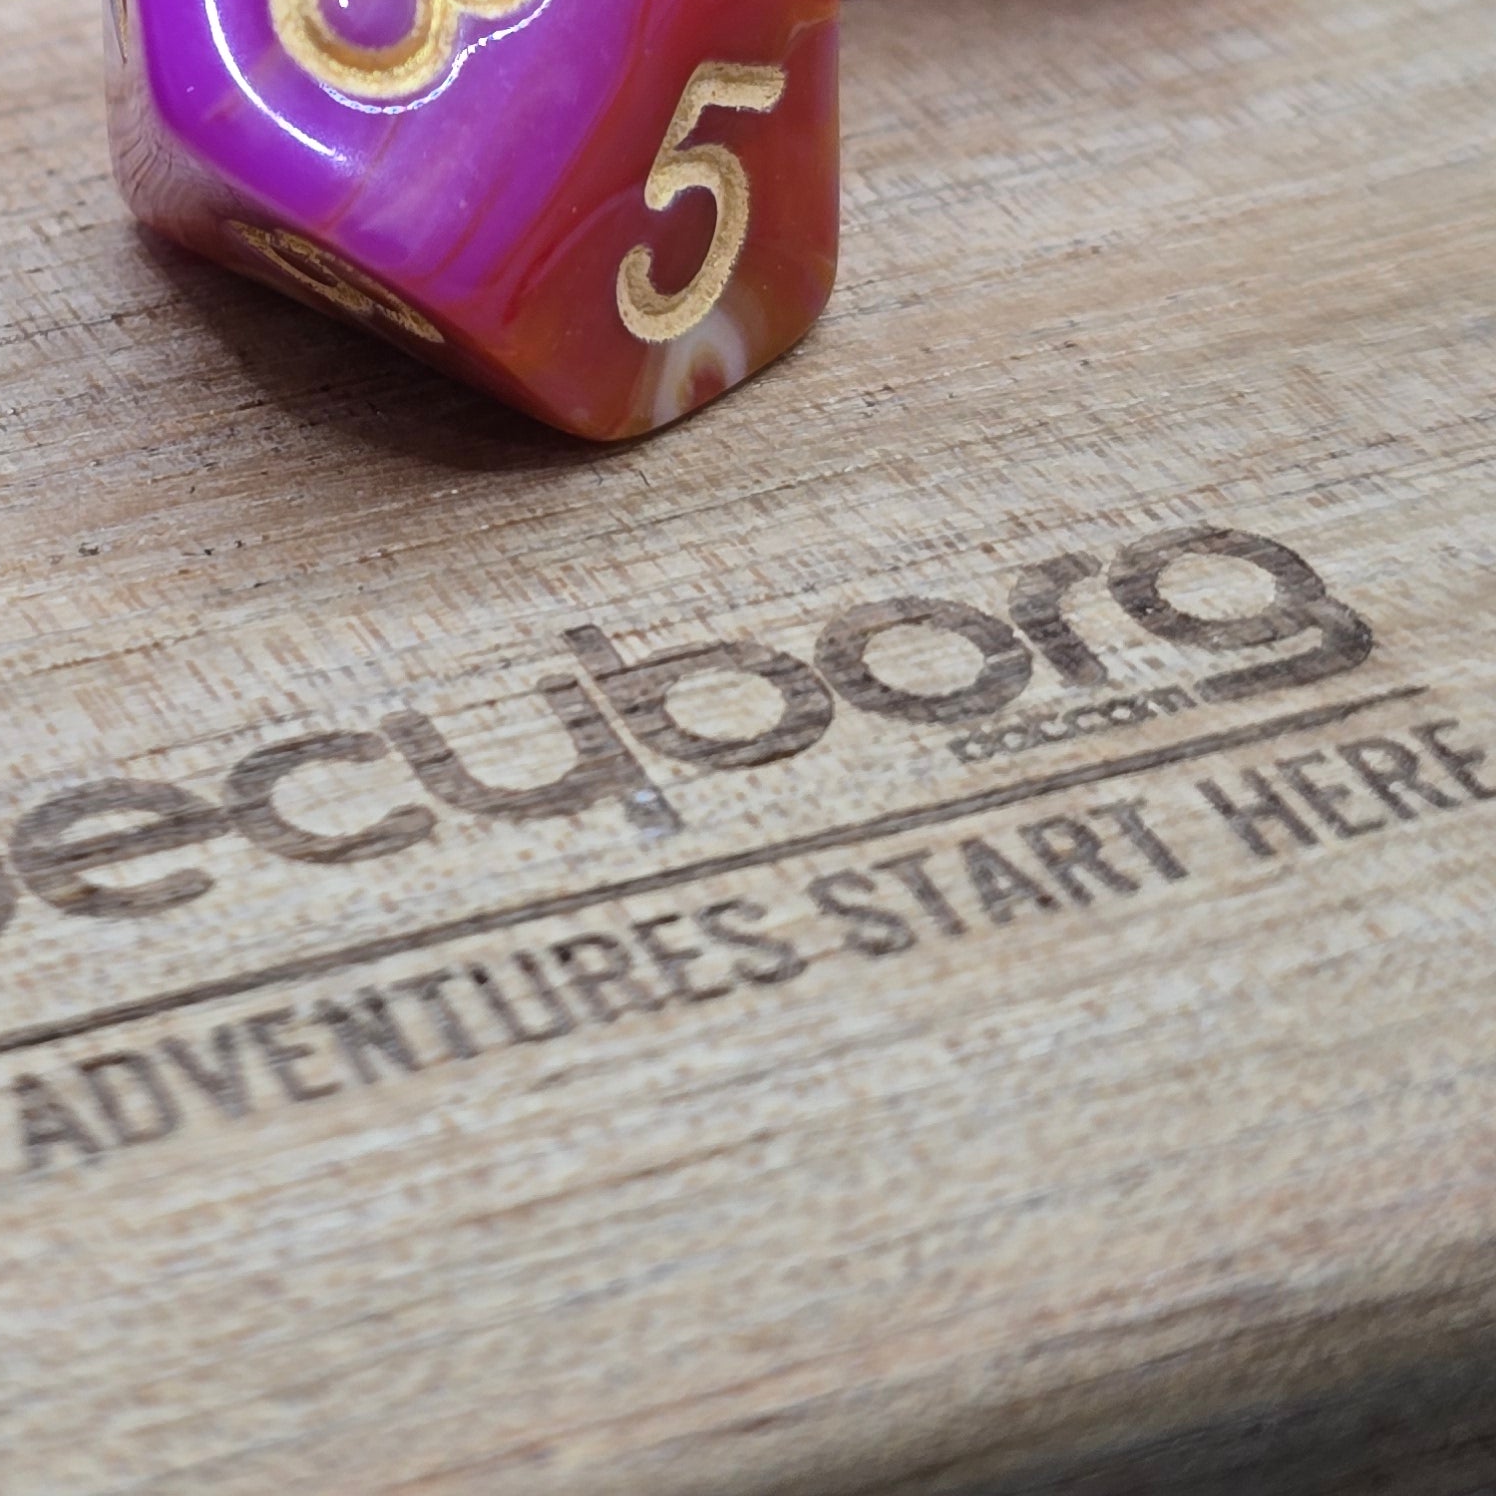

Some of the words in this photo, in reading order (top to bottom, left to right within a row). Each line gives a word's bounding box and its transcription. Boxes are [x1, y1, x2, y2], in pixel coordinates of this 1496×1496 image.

[615, 61, 787, 345] 5
[12, 901, 810, 1172] ADVENTURES
[807, 794, 1189, 957] START
[1196, 716, 1496, 862] HERE
